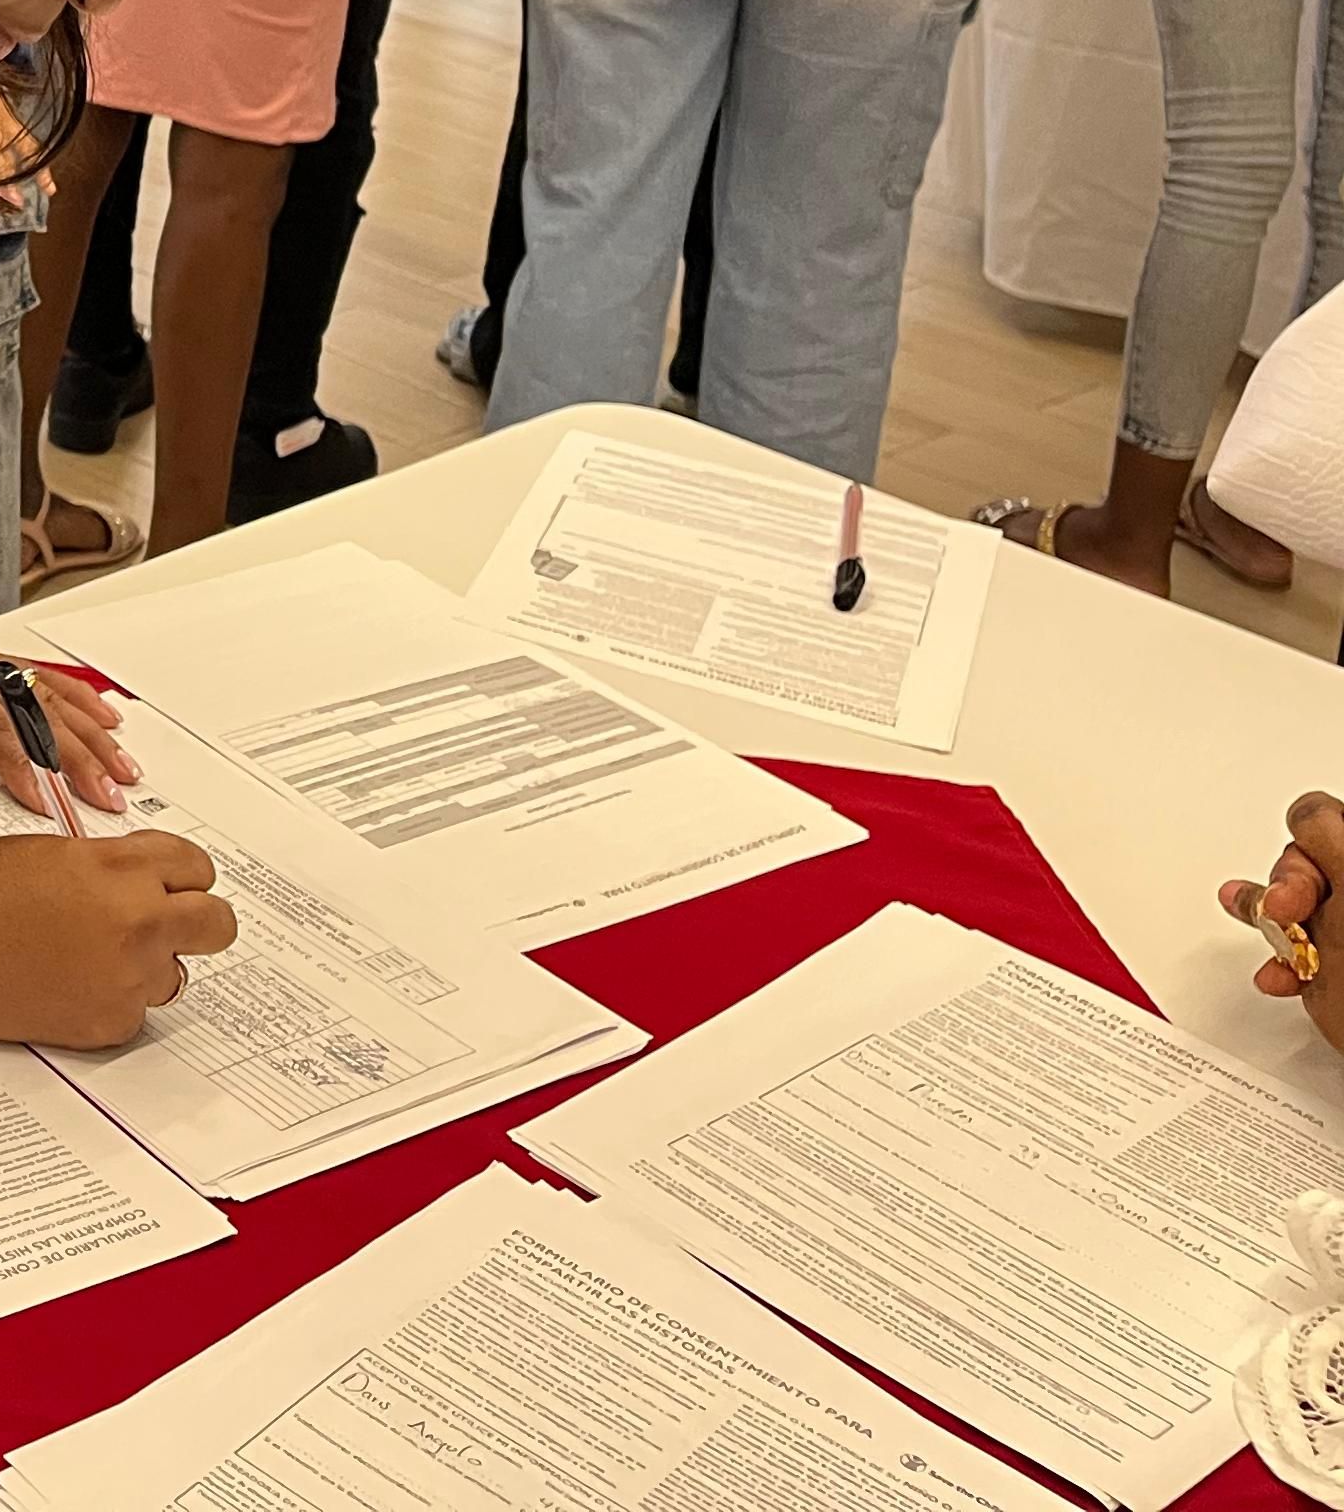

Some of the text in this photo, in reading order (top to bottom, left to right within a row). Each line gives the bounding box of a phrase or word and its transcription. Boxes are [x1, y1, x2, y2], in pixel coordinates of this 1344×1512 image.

[60, 1209, 146, 1241] COMPARTIR
[65, 1220, 160, 1256] FORMULARIO
[32, 1236, 60, 1250] LAS
[40, 1252, 64, 1264] DE
[503, 1238, 735, 1374] COMPARTIR LAS HISTORIAS
[510, 1230, 872, 1439] FORMULARIO DE CONSENTIMIENTO PARA
